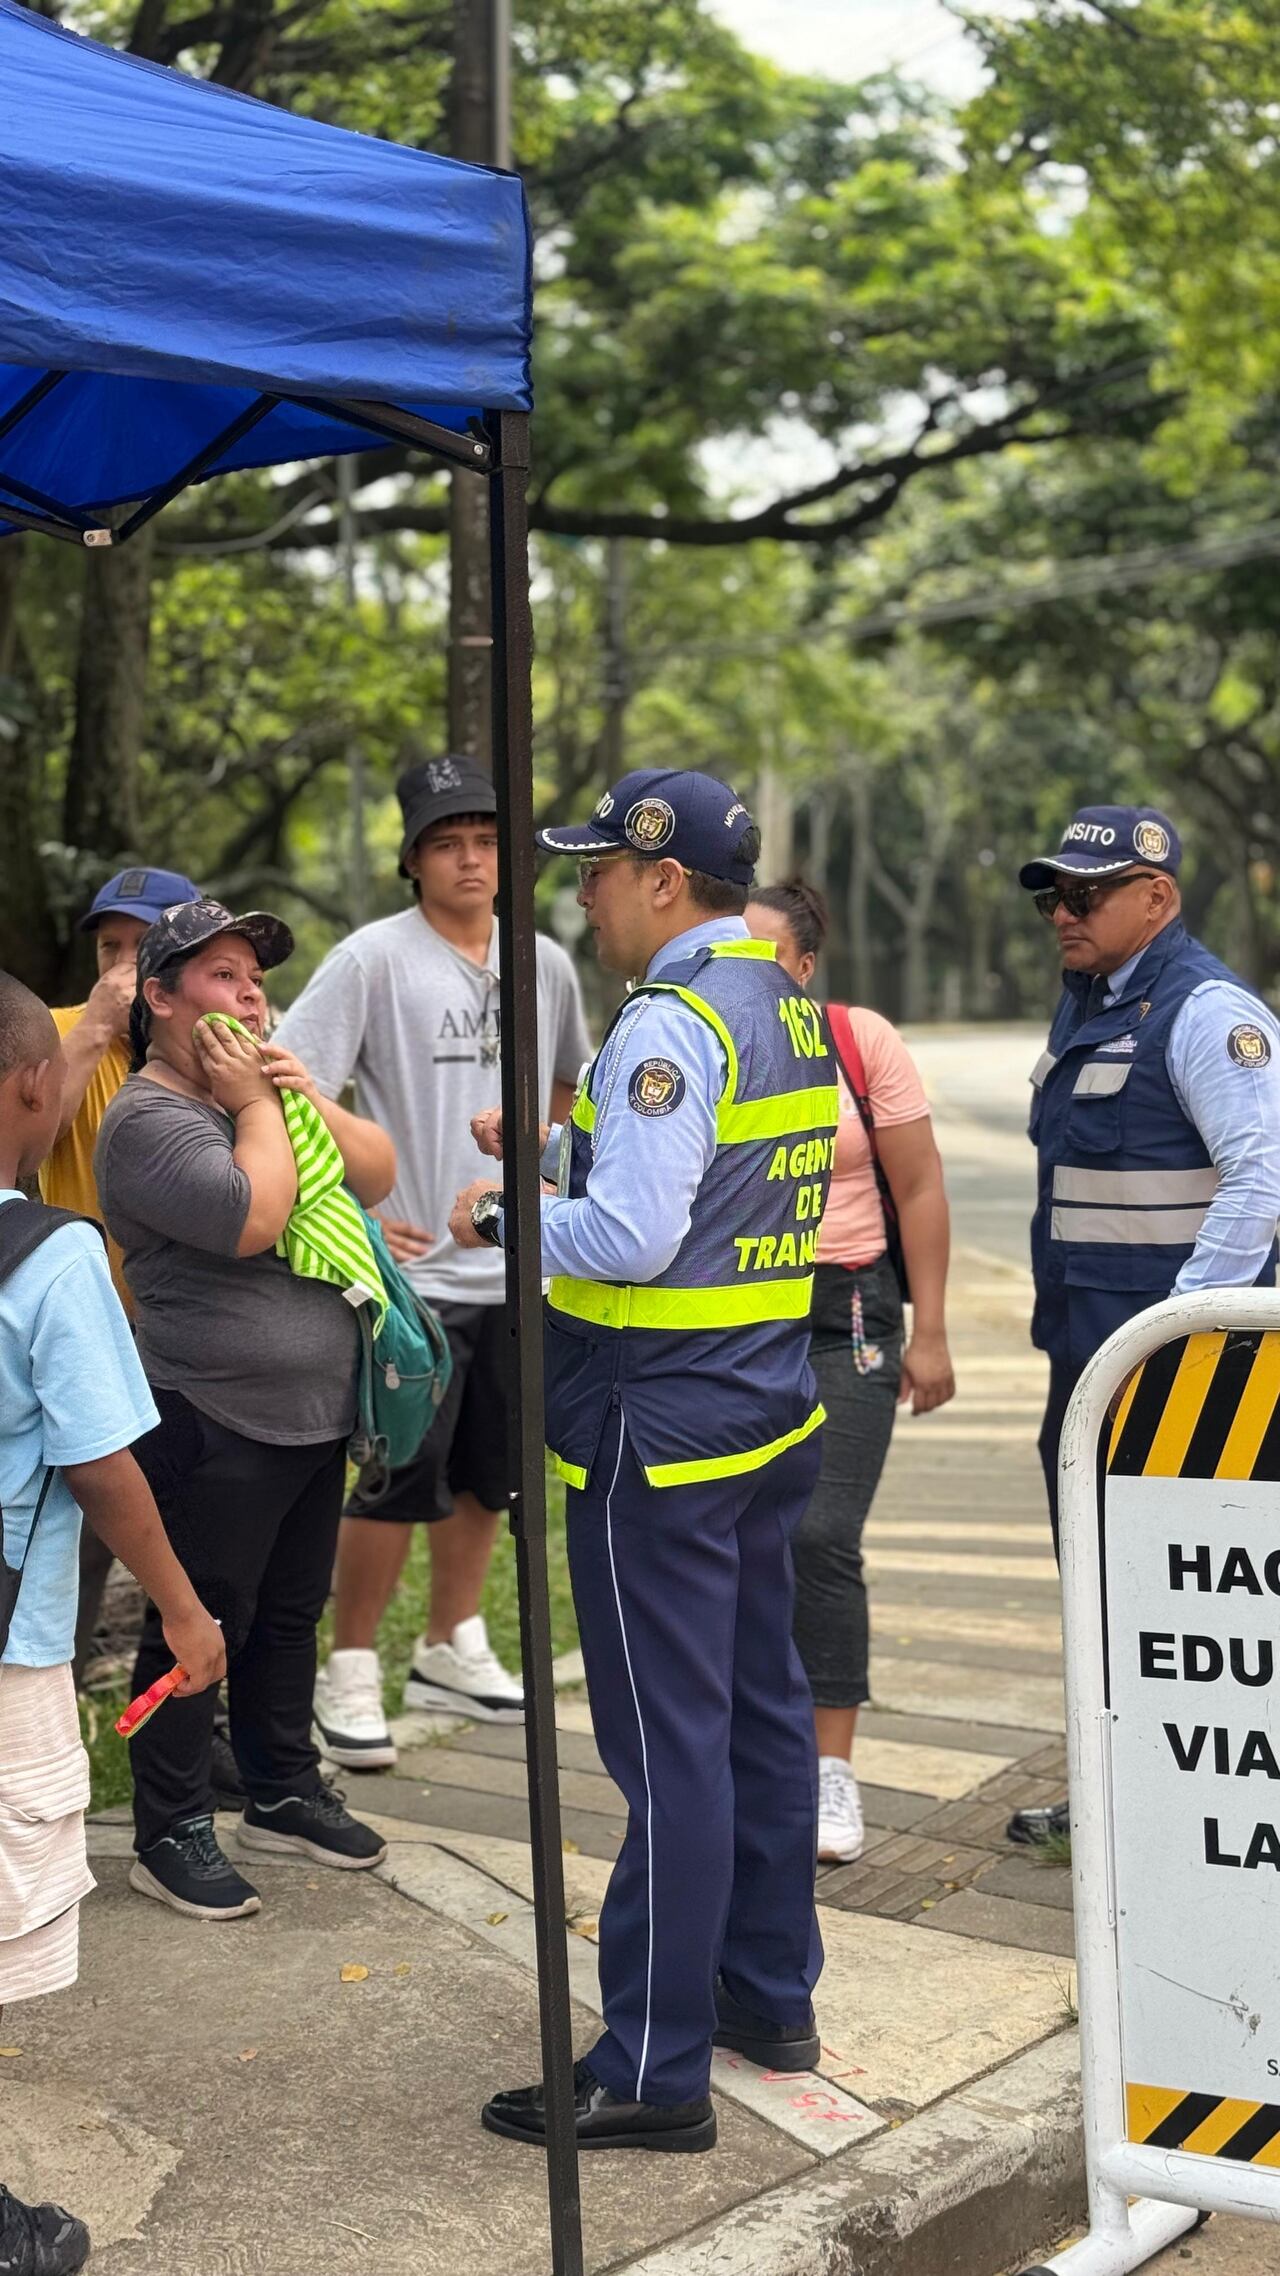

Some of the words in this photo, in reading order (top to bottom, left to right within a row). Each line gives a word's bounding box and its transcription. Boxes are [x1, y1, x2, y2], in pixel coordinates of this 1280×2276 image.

[778, 996, 828, 1059] 162
[633, 1101, 673, 1116] COLOMBIA
[795, 1182, 823, 1221] DE
[1138, 1631, 1274, 1688] EDU
[1162, 1722, 1280, 1780] VIA
[1203, 1816, 1280, 1873] LA
[1266, 2058, 1280, 2077] S
